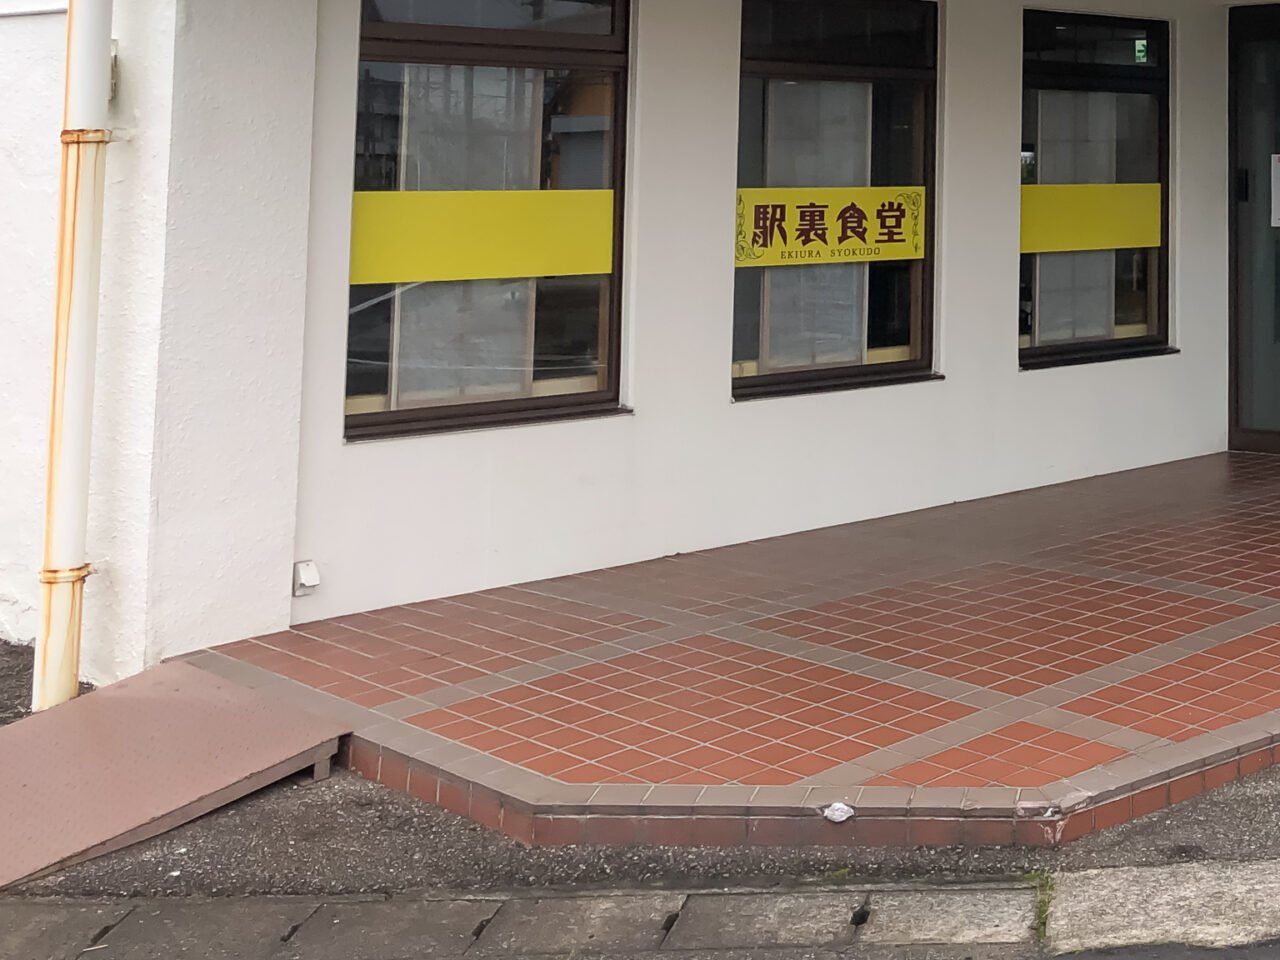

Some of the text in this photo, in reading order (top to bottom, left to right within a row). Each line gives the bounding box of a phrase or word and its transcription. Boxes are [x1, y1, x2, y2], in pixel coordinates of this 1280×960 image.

[751, 201, 906, 248] 駅裏食堂
[780, 247, 881, 259] EKIURA SYOKUDO
